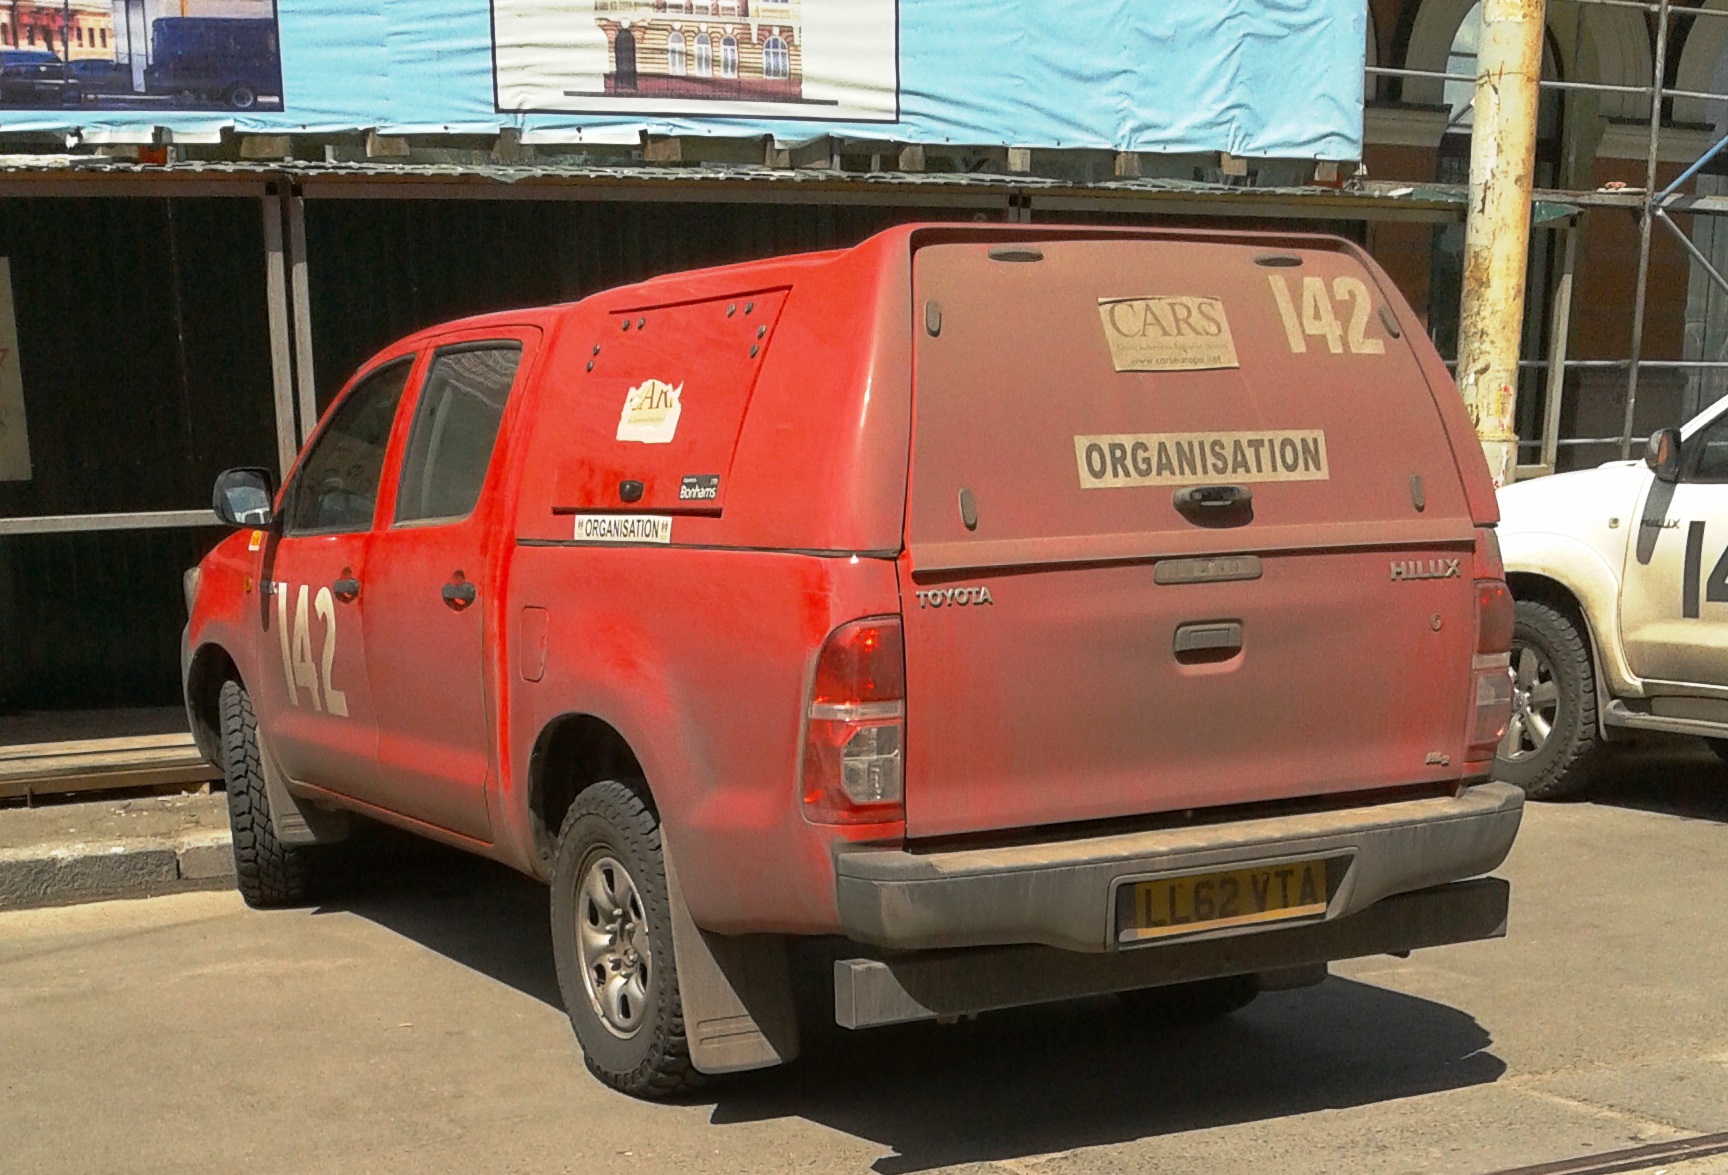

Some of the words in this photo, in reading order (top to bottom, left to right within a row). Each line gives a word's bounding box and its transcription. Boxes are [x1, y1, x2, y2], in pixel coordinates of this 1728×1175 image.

[1108, 301, 1222, 338] CARS
[1268, 275, 1386, 354] 142
[1085, 437, 1322, 480] ORGANISATION
[680, 484, 717, 499] Bonhams
[585, 519, 660, 538] ORGANISATION
[1390, 559, 1461, 581] HILUX
[916, 586, 993, 608] TOYOTA
[278, 582, 349, 718] 142
[1144, 876, 1238, 927] LL62
[1251, 866, 1318, 913] VTA
